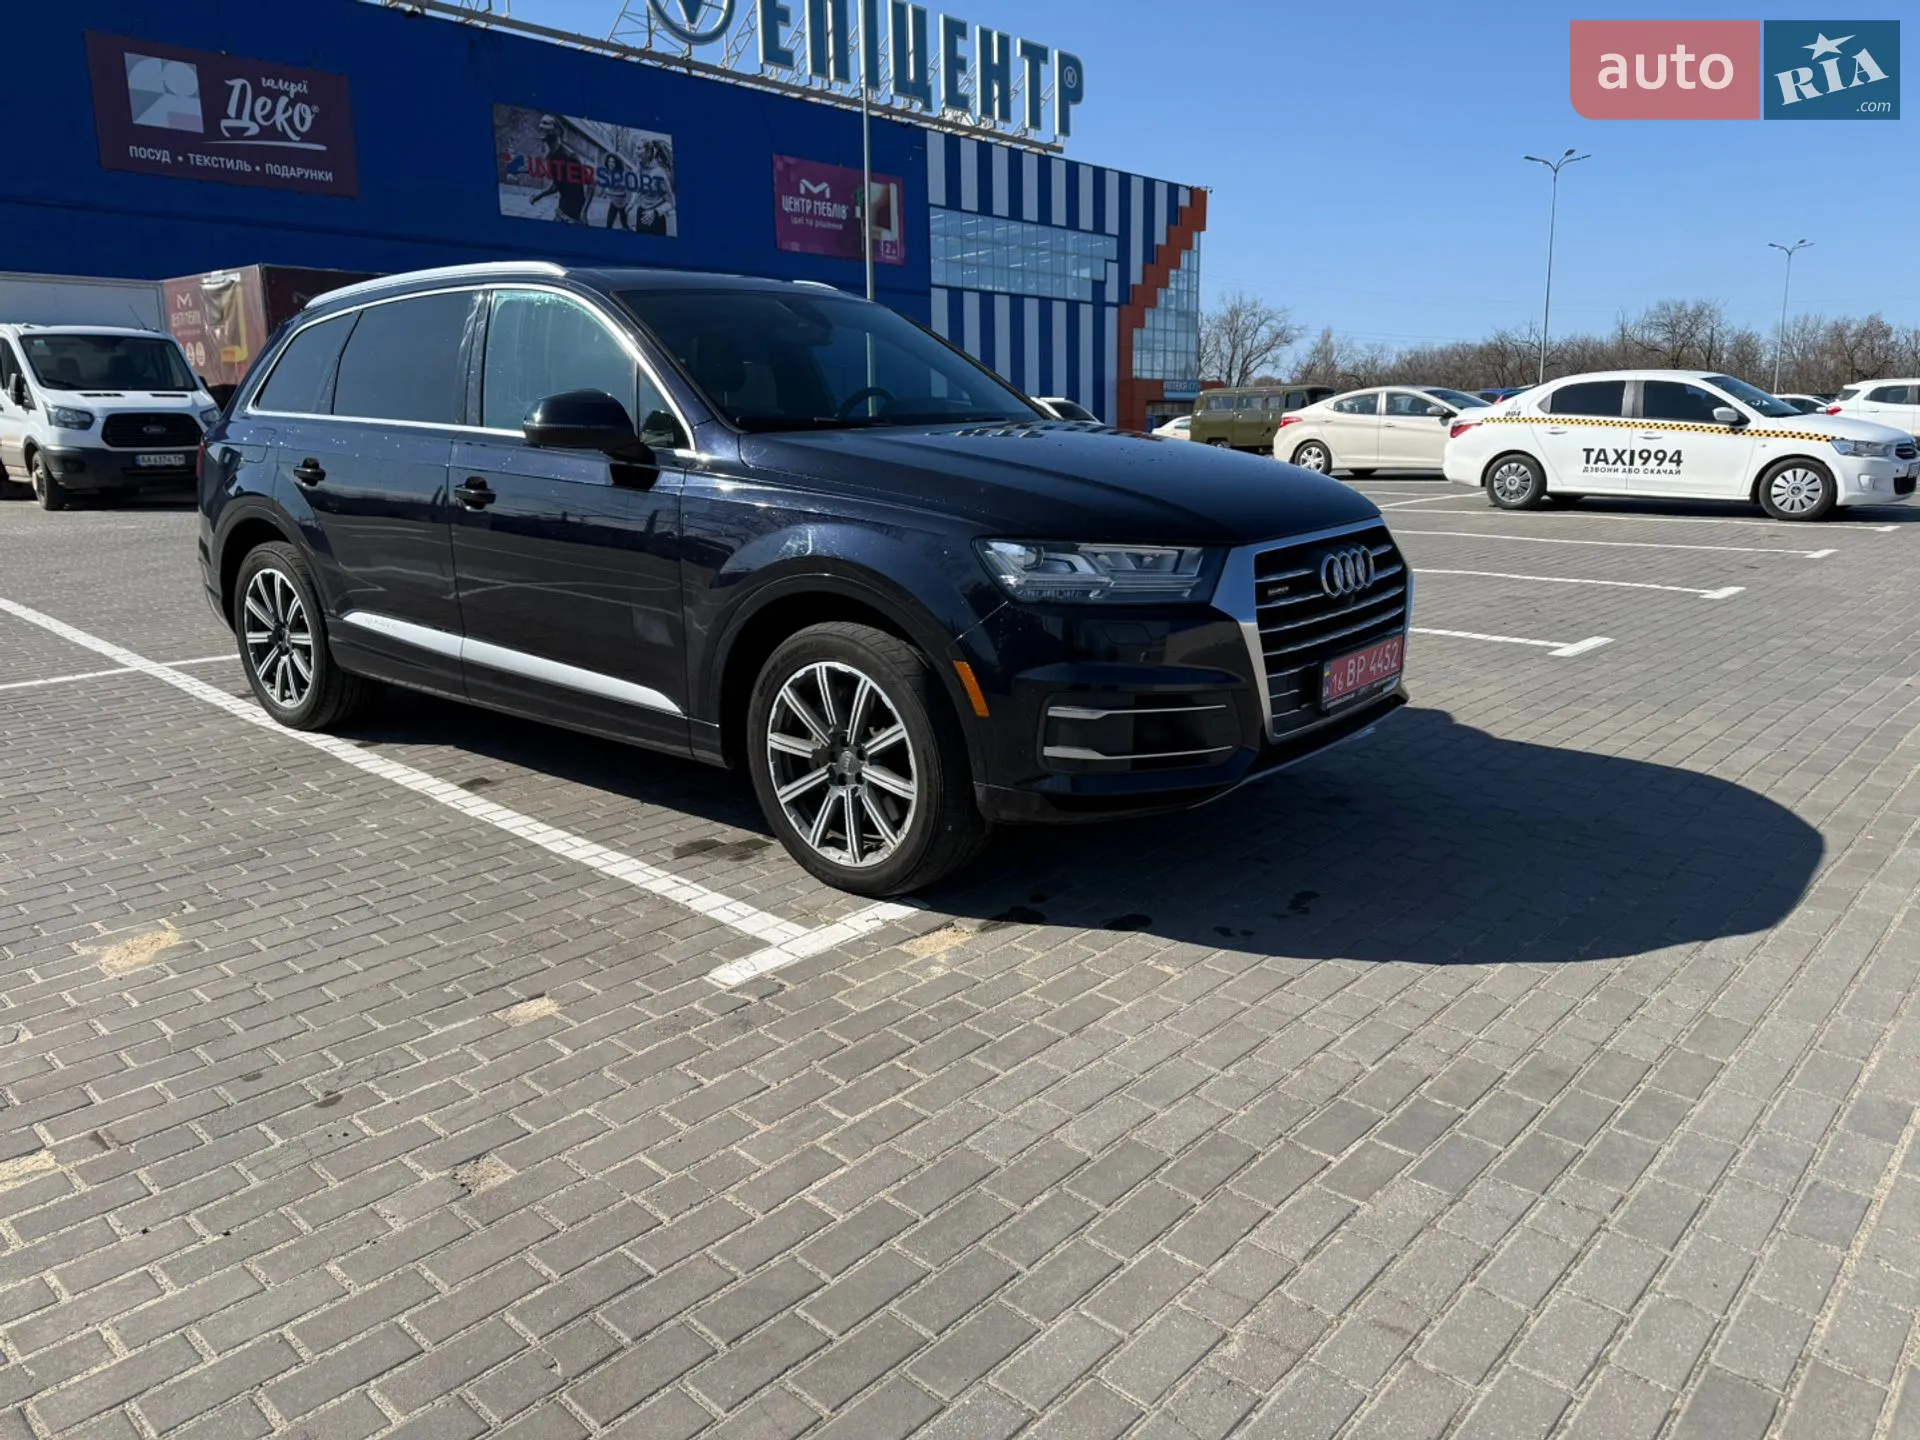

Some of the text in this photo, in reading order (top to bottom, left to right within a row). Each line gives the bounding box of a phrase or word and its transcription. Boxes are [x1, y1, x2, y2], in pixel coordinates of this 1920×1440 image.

[220, 78, 315, 141] Деко
[129, 145, 333, 182] ПОСУД ТЕКСТИЛЬ ПОДАРУНКИ
[782, 195, 812, 214] ЦЕНТР
[1582, 448, 1683, 467] TAXI994
[1582, 466, 1619, 474] ДЗВОНИ
[1621, 467, 1640, 475] АБО
